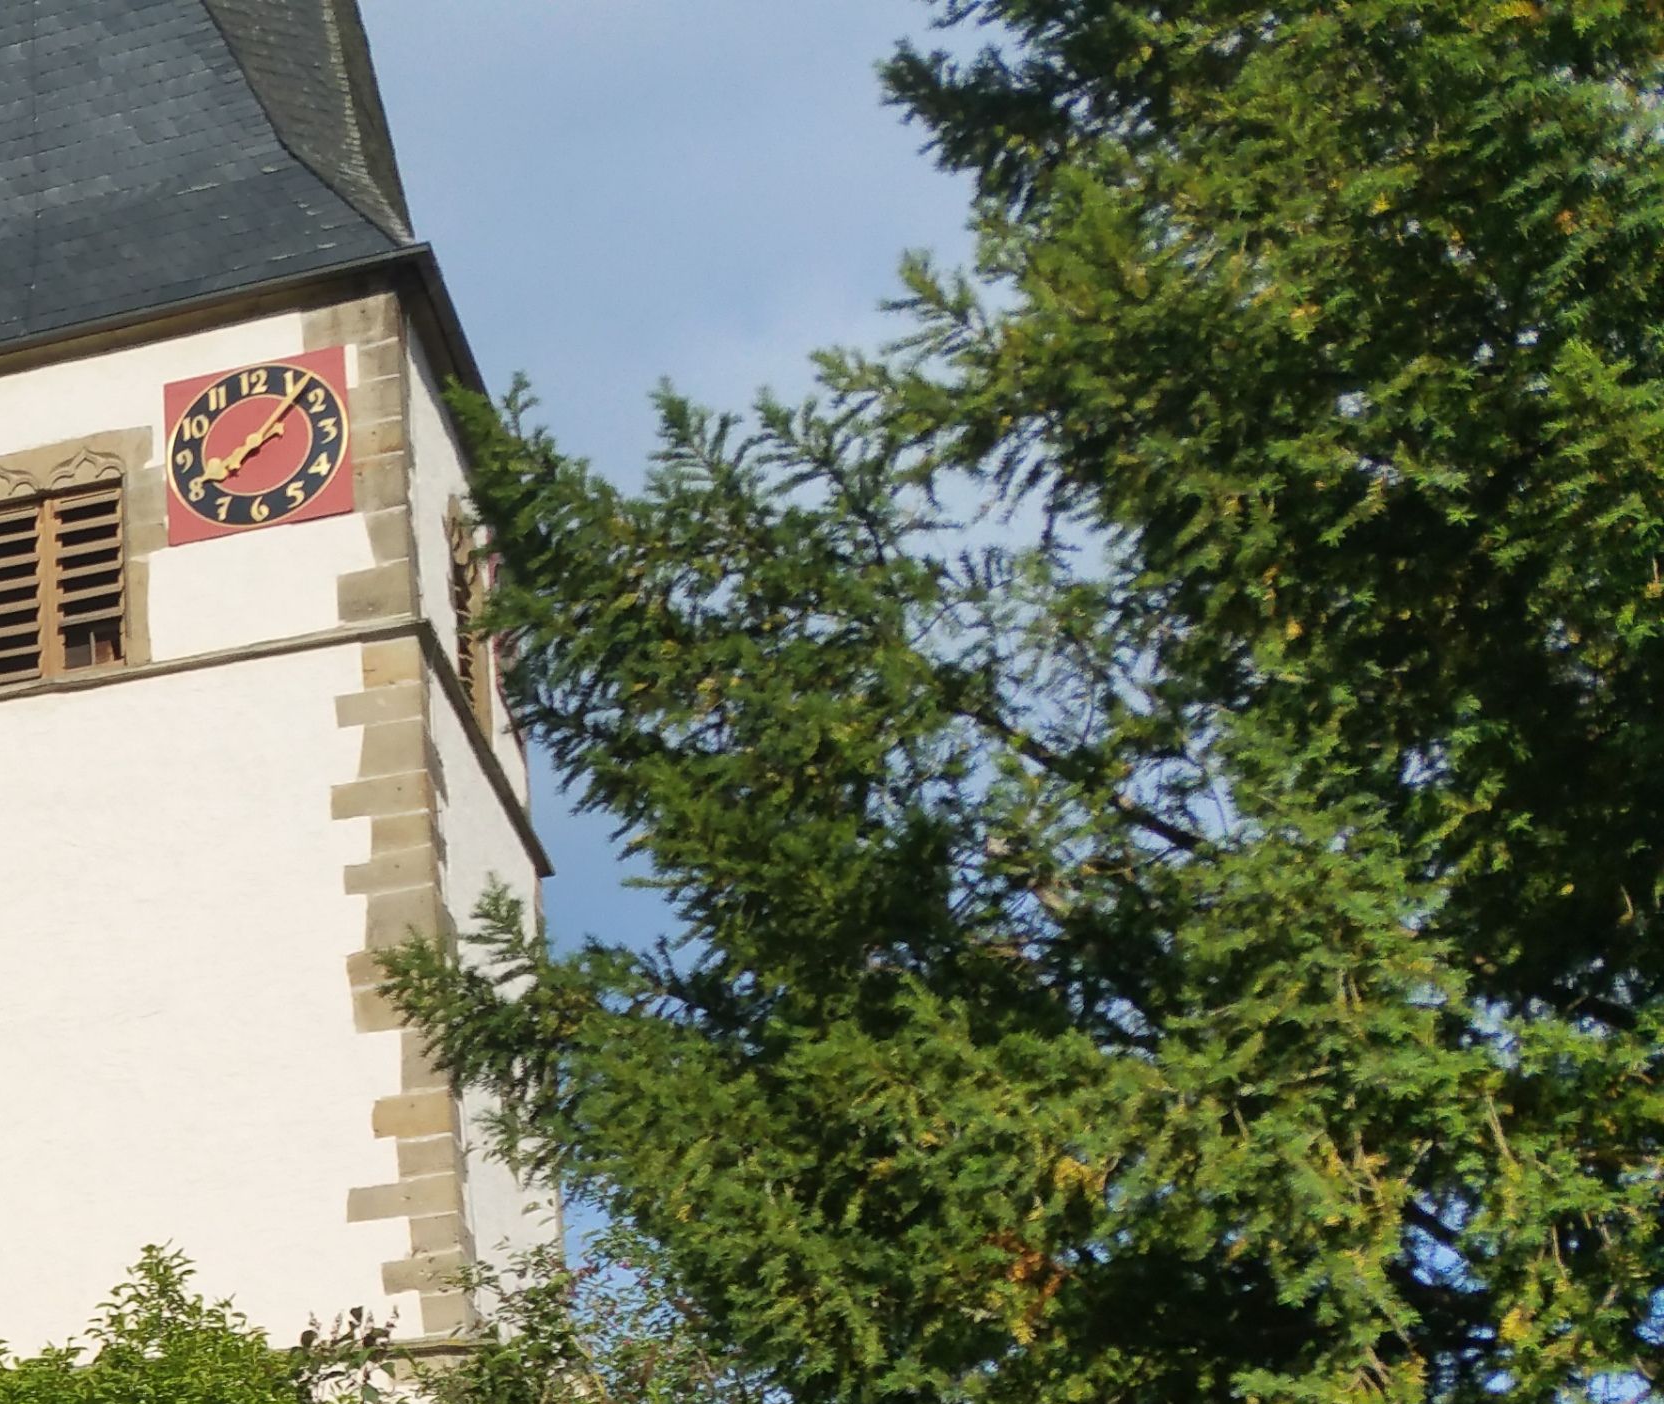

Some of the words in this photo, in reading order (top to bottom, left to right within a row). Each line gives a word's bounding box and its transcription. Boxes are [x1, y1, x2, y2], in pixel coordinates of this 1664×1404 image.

[238, 368, 269, 395] 12
[283, 370, 296, 395] 1
[207, 385, 228, 411] 11
[307, 387, 327, 414] 2
[181, 414, 210, 442] 10
[317, 416, 338, 444] 3
[175, 448, 194, 473] 9
[307, 452, 332, 477] 4
[188, 477, 206, 503] 8
[286, 480, 305, 509] 5
[215, 495, 232, 521] 7
[250, 495, 270, 521] 6
